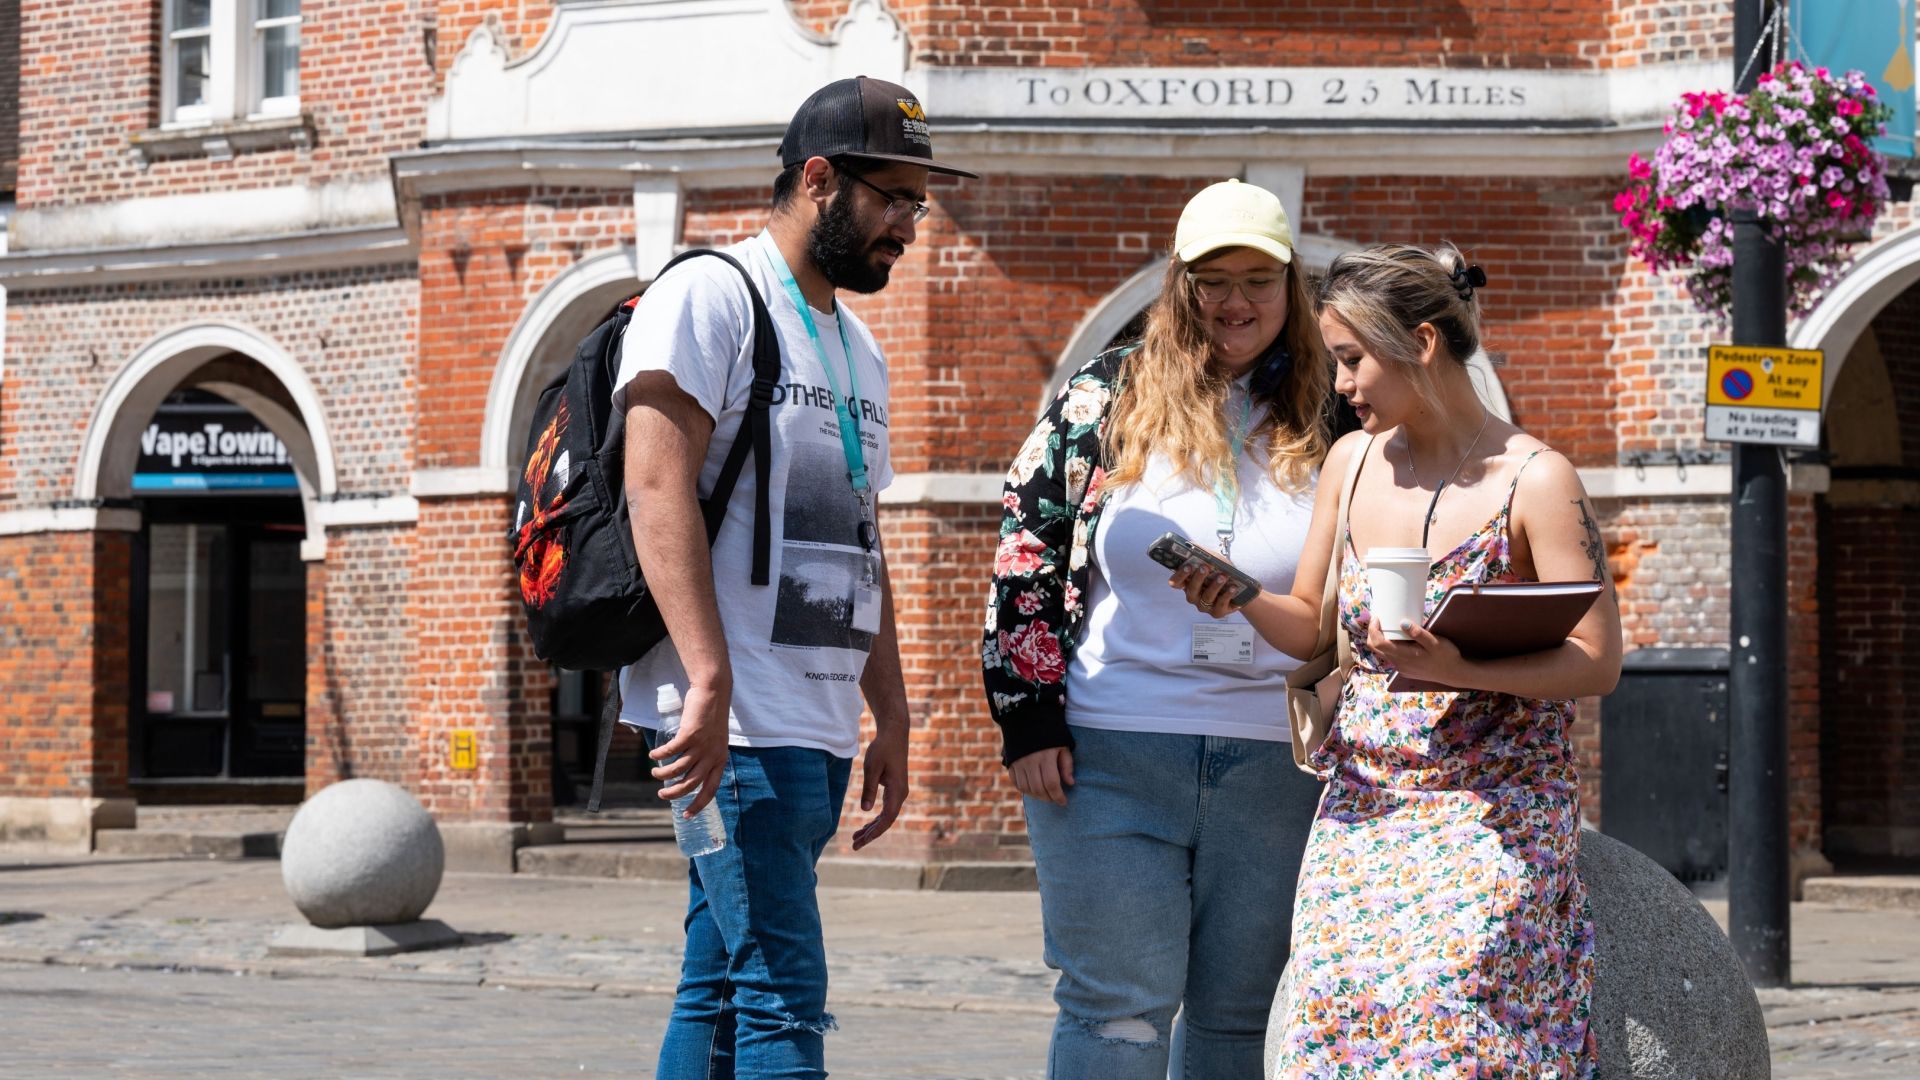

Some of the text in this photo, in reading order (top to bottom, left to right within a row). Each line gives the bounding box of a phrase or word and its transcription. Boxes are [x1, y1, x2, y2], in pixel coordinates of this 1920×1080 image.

[1084, 78, 1293, 106] OXFORD
[1322, 78, 1380, 105] 25
[1788, 354, 1817, 366] Zone
[1767, 374, 1809, 388] At any
[1774, 388, 1801, 399] time
[844, 394, 888, 429] ORLD
[1729, 412, 1798, 427] No loading
[1726, 426, 1797, 439] at any time
[805, 671, 849, 682] KNOWEDGE
